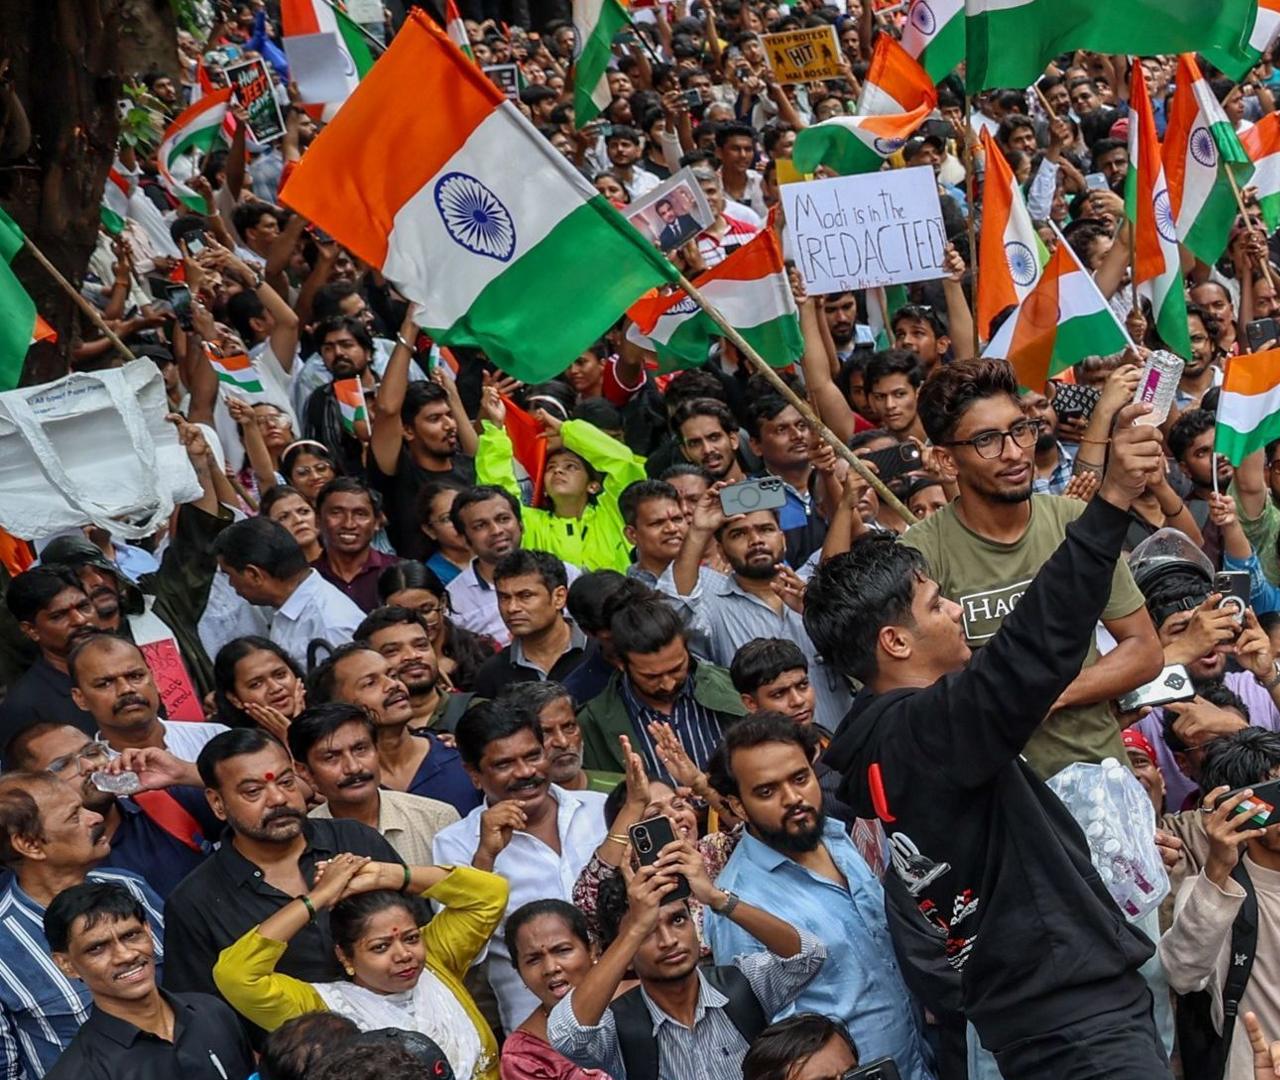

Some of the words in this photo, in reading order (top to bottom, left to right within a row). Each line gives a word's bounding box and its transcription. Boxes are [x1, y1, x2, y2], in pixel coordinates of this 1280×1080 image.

[786, 30, 829, 41] PROTEST
[788, 44, 813, 67] HIT
[795, 188, 849, 232] Modi
[852, 207, 865, 225] is
[867, 204, 882, 223] in
